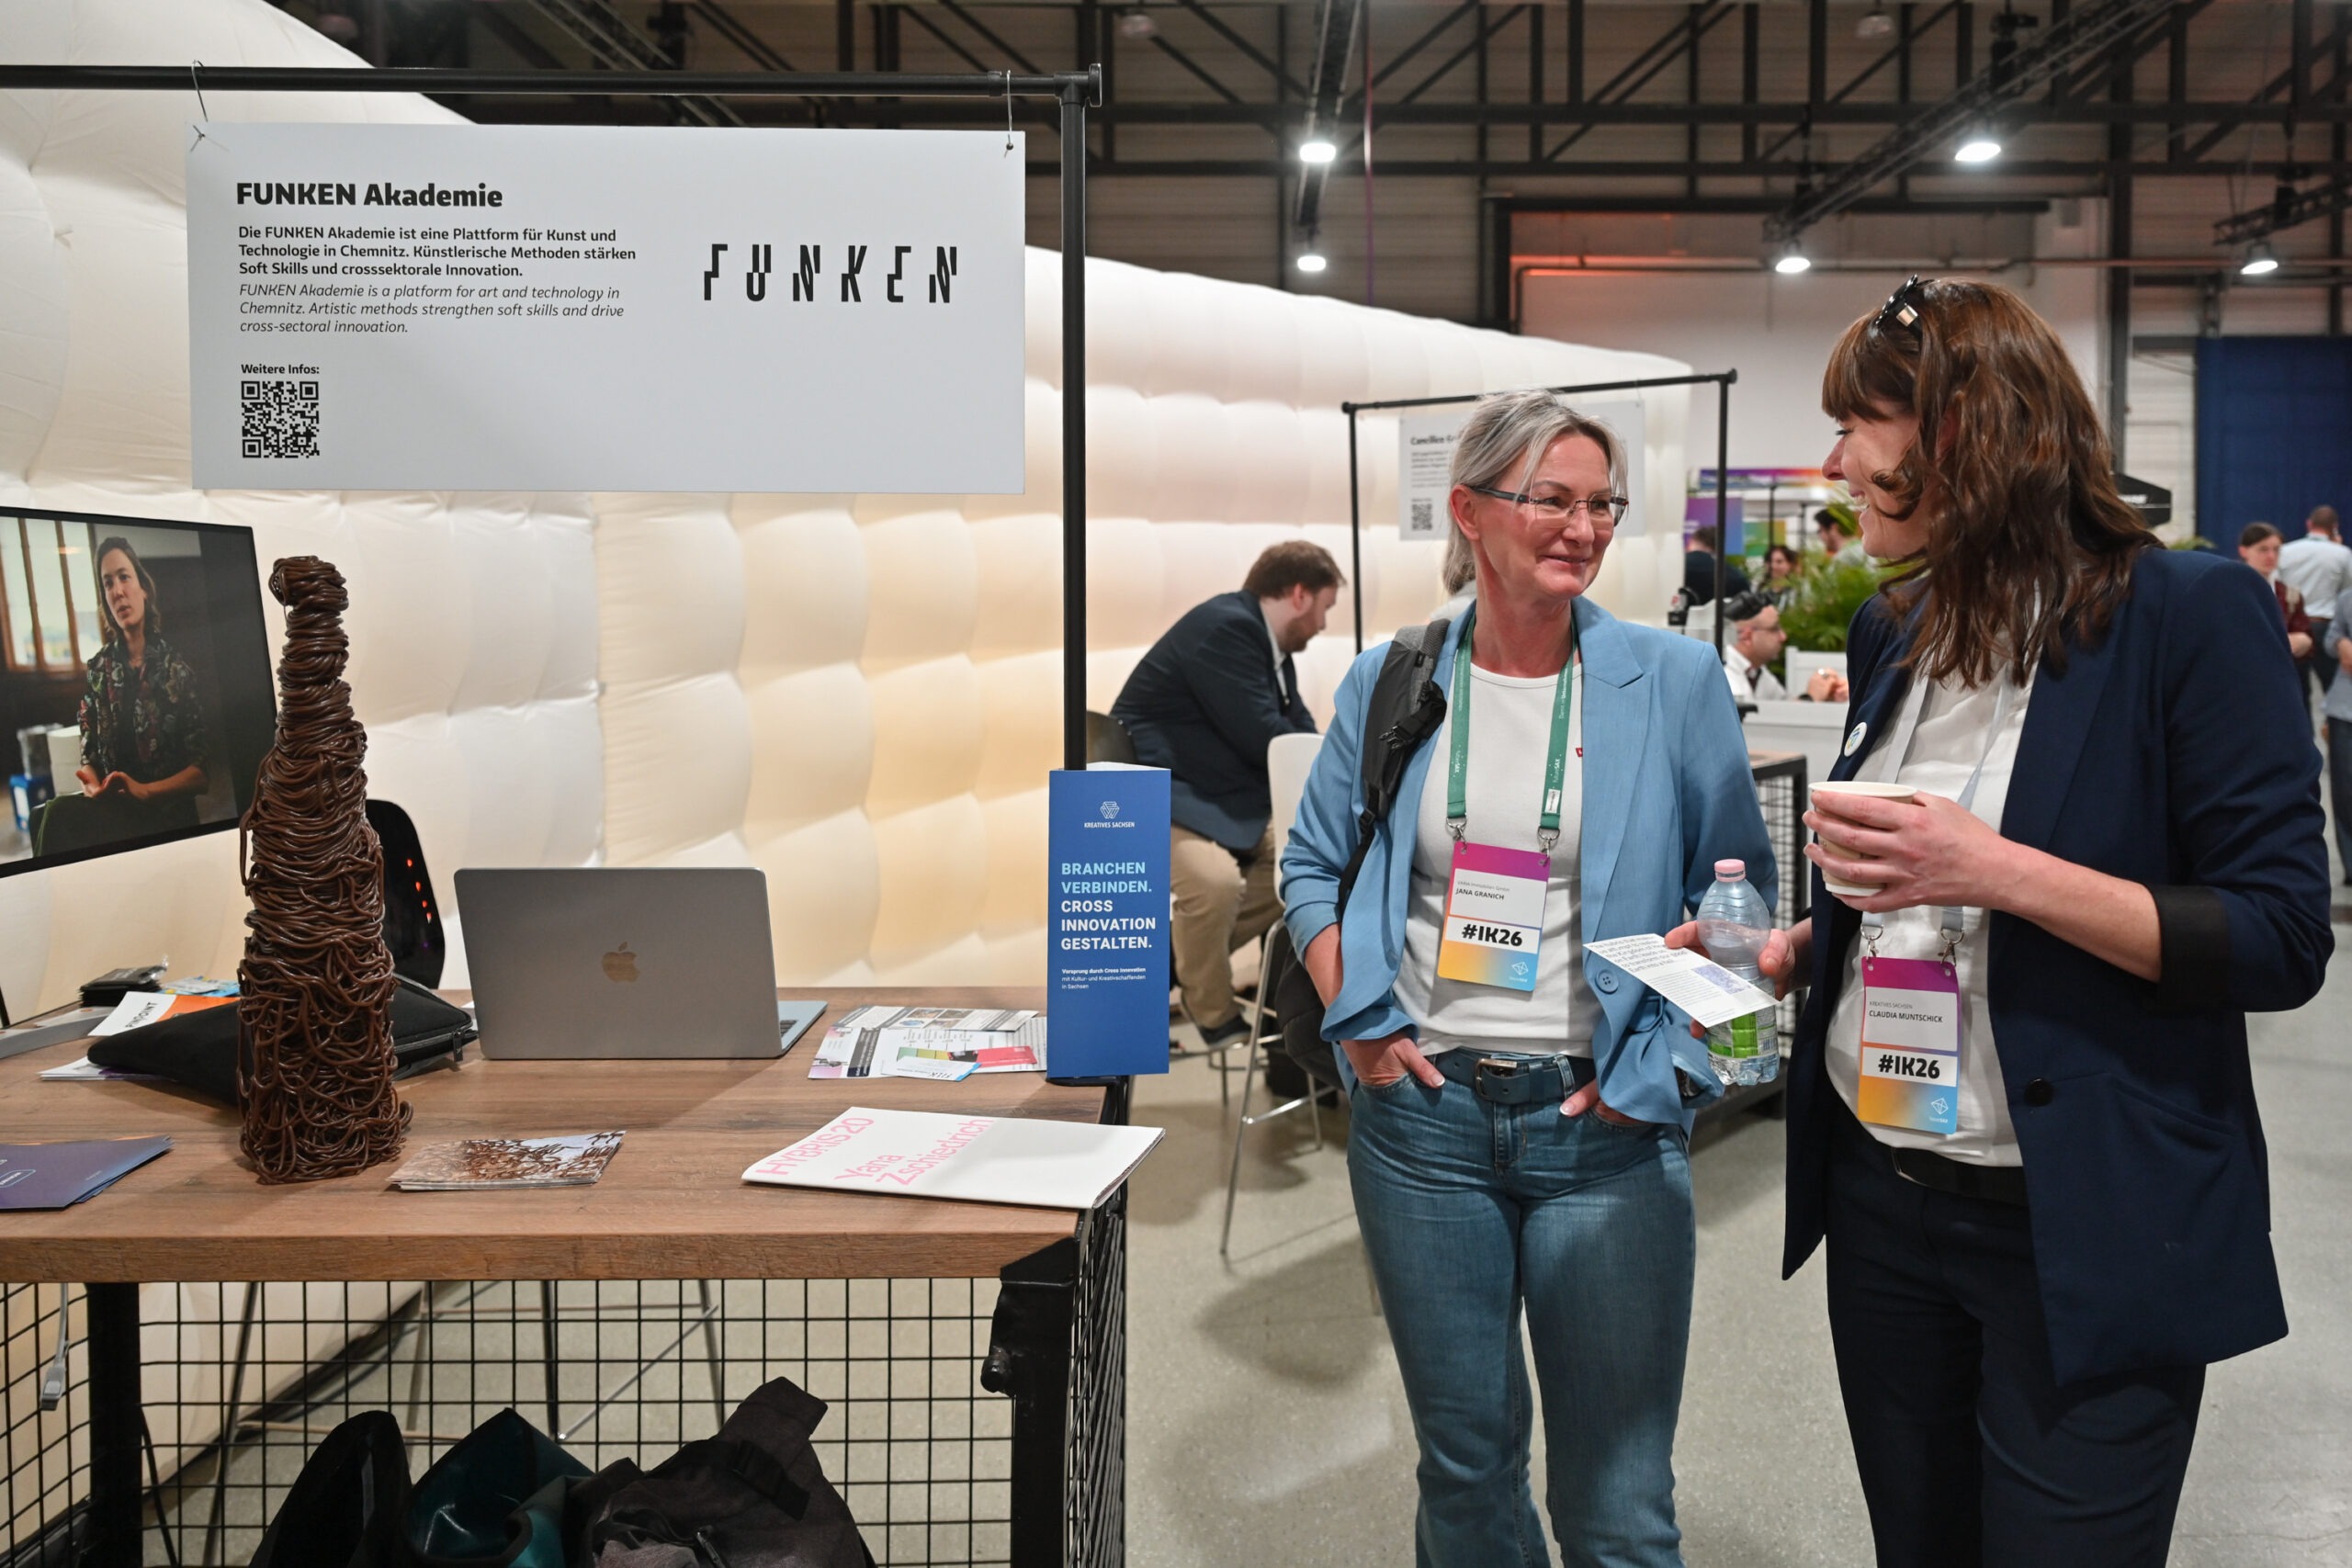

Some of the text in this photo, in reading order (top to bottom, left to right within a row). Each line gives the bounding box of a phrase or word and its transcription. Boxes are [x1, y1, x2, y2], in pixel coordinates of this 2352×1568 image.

[237, 182, 503, 208] FUNKEN Akademie
[239, 225, 616, 242] Die FUNKEN Akademie ist eine Plattform für Kunst und
[239, 243, 636, 260] Technologie in Chemnitz. Künstlerische Methoden stärken
[239, 262, 522, 276] Soft Skills und crosssektorale Innovation.
[704, 243, 956, 303] FUNKEN
[240, 283, 619, 302] FUNKEN Akademie is a platform for art and technology in
[240, 301, 624, 319] Chemnitz. Artistic methods strengthen soft skills and drive
[241, 319, 407, 333] cross-sectoral innovation.
[241, 364, 319, 374] Weitere Infos:
[1062, 862, 1145, 874] BRANCHEN
[1061, 881, 1151, 894] VERBINDEN.
[1455, 887, 1505, 900] JANA GRANICH
[1061, 899, 1113, 913] CROSS
[1062, 917, 1155, 931] INNOVATION
[1462, 923, 1522, 947] #IK26
[1061, 936, 1151, 950] GESTALTEN.
[1869, 1010, 1943, 1023] CLAUDIA MUNTSCHICK
[1878, 1054, 1940, 1079] #IK26
[875, 1118, 995, 1185] Zschiedrich
[834, 1154, 903, 1181] Yana
